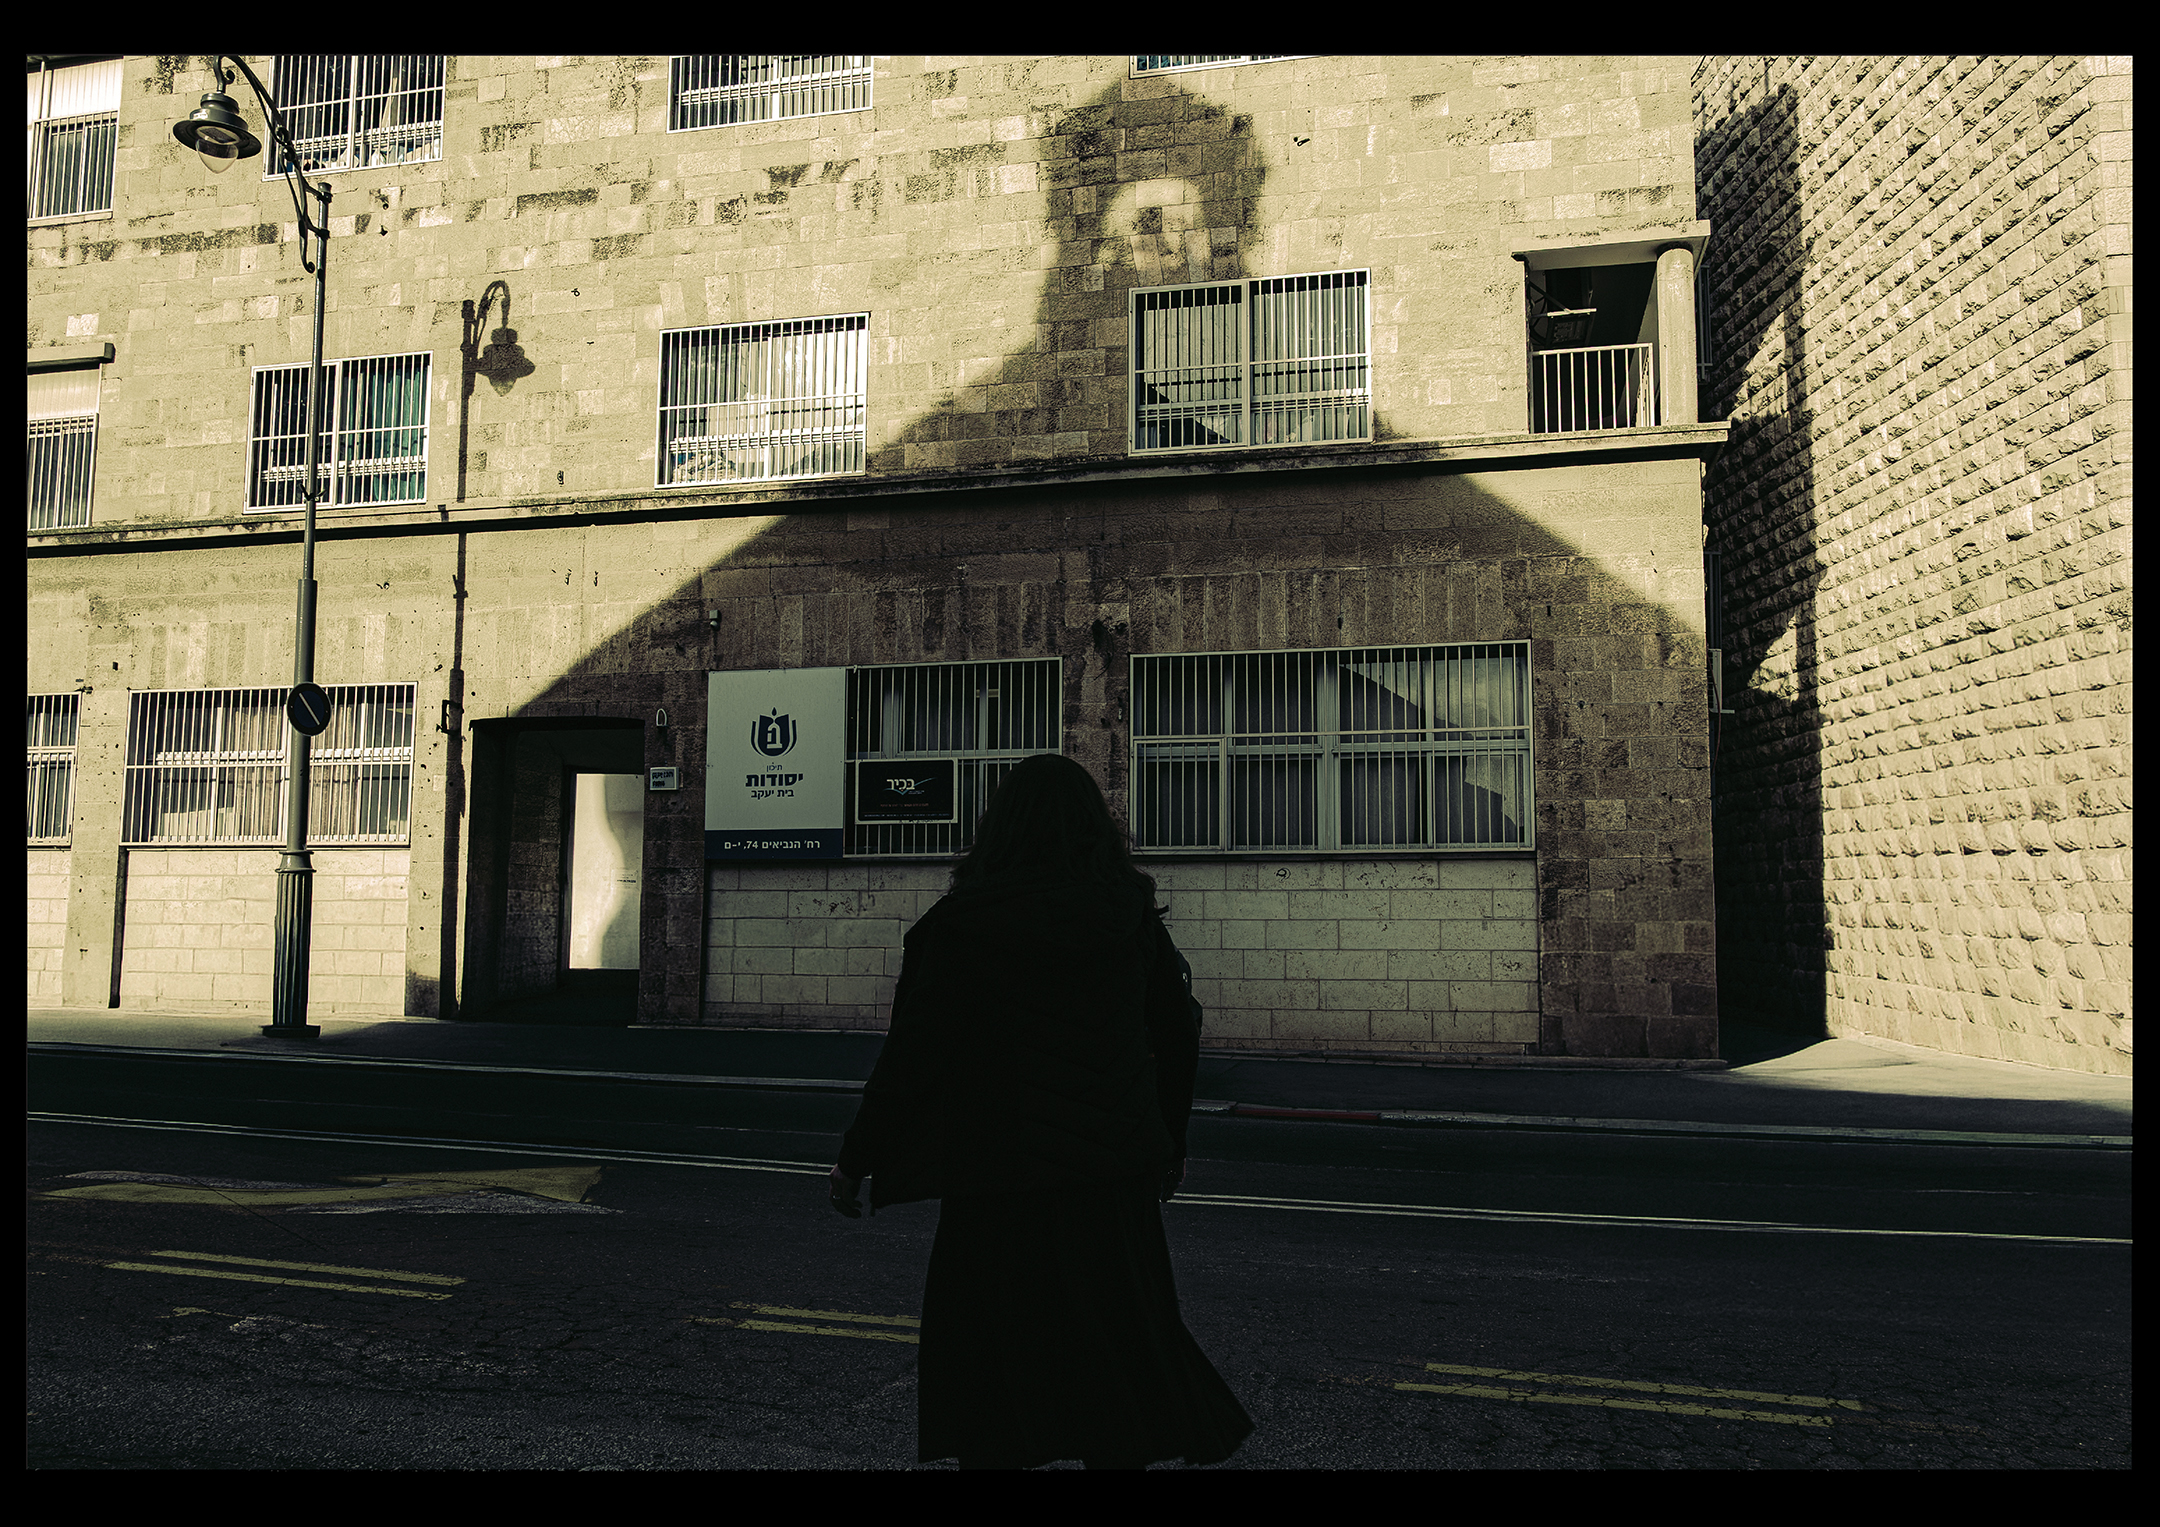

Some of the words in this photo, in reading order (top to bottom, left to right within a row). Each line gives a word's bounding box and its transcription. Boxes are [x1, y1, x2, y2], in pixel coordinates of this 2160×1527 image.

[766, 764, 783, 772] תיכון
[745, 774, 803, 787] יסודות
[751, 790, 774, 800] יעקב
[777, 789, 794, 798] בית
[743, 840, 759, 850] 74,
[761, 840, 801, 849] הנביאים
